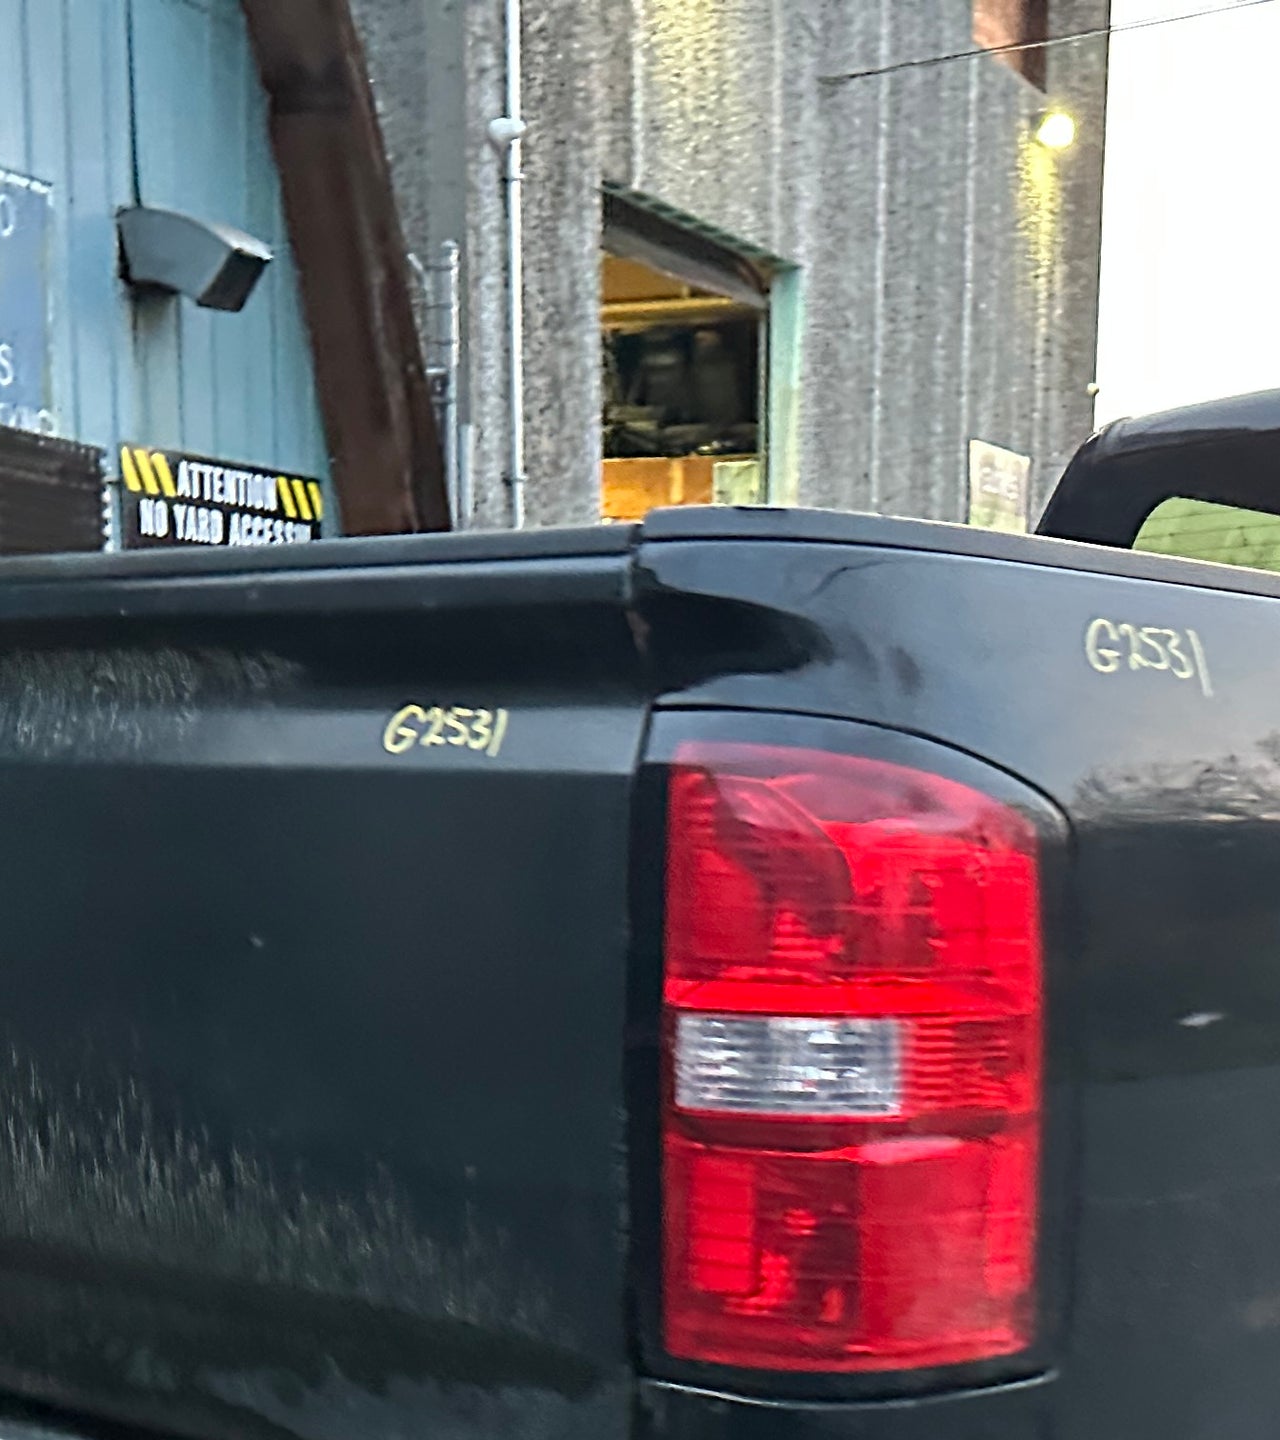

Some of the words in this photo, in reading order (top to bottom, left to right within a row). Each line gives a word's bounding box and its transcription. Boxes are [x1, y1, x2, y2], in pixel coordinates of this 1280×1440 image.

[177, 460, 279, 512] ATTENTION
[139, 497, 169, 538] NO
[172, 502, 225, 545] YARD
[1085, 617, 1215, 698] G2531
[383, 703, 509, 758] G2531
